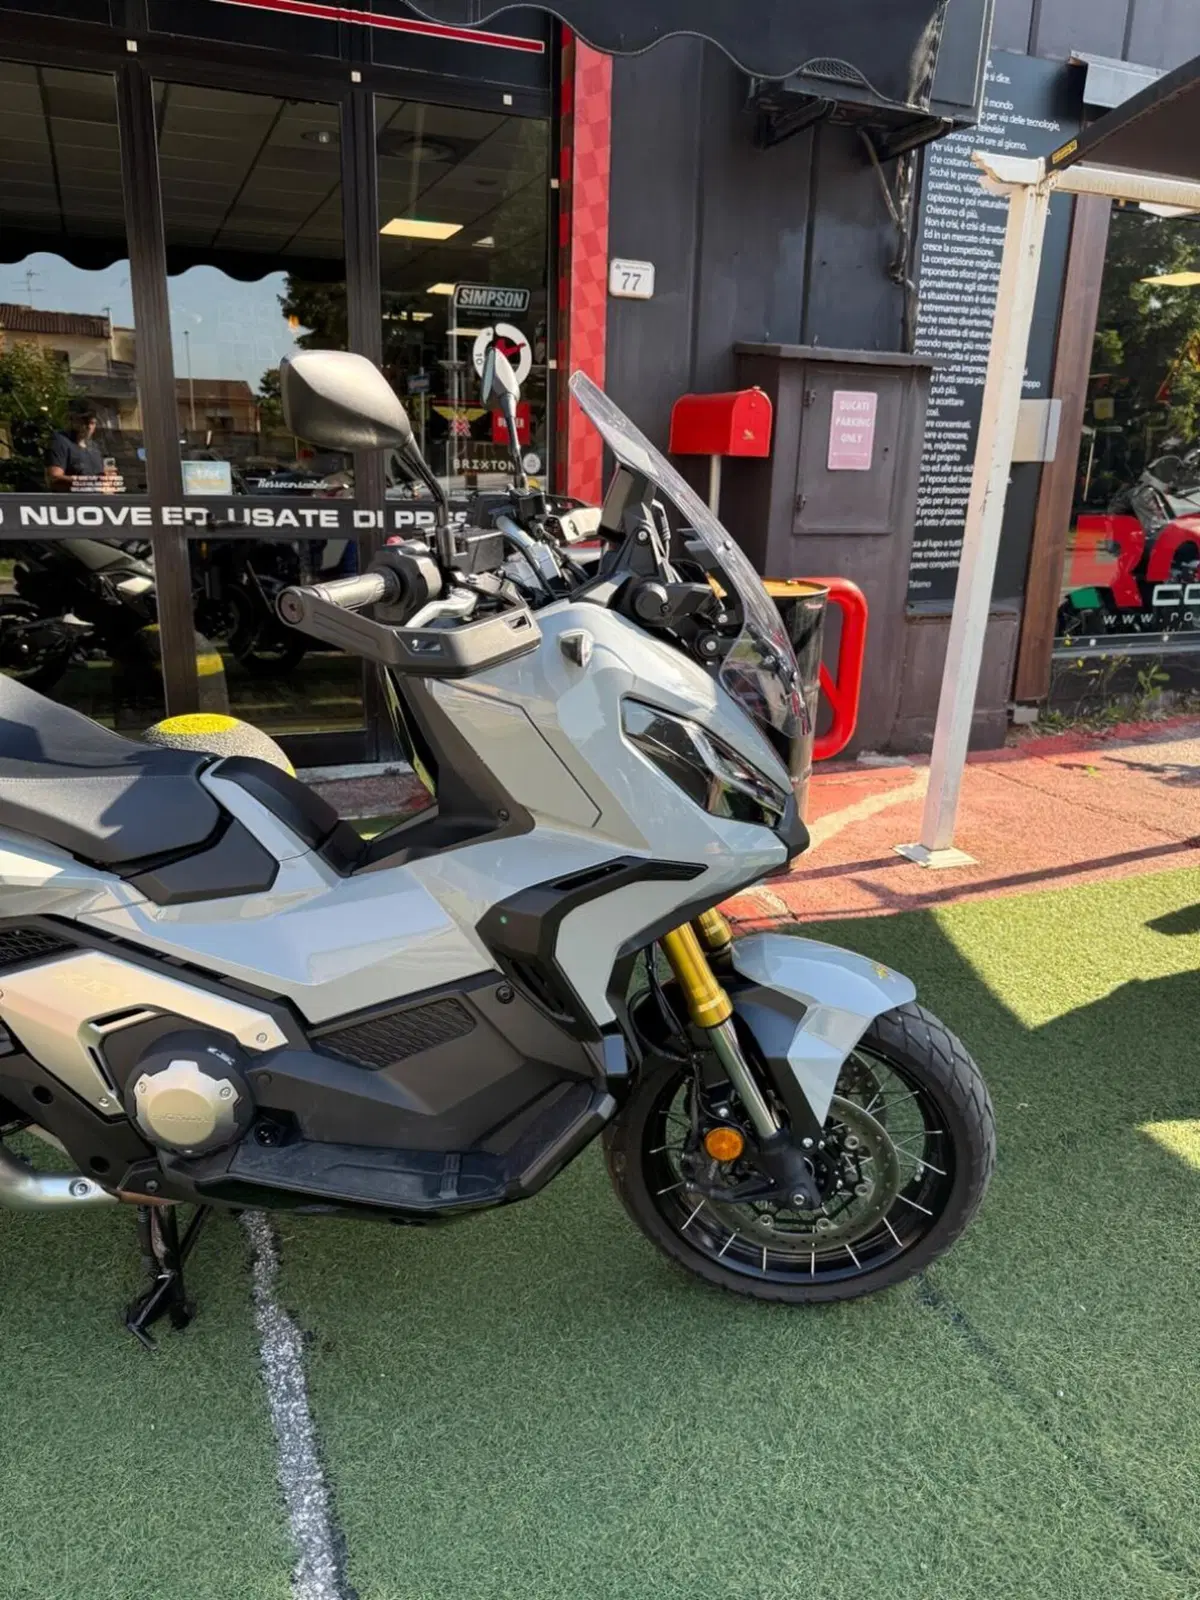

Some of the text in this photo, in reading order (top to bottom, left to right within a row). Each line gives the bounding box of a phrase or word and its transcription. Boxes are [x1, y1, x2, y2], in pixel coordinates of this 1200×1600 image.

[989, 99, 1014, 111] mondo
[1009, 114, 1026, 126] delle
[931, 141, 943, 151] Per
[943, 143, 953, 153] via
[976, 135, 985, 144] 24
[985, 137, 997, 147] ore
[930, 155, 943, 164] che
[943, 157, 969, 168] costano
[926, 204, 959, 217] Chiedono
[925, 217, 940, 227] Non
[924, 229, 933, 239] Ed
[923, 243, 943, 252] cresce
[922, 254, 930, 263] La
[931, 255, 975, 267] competizione
[622, 272, 642, 291] 77
[460, 288, 526, 308] SIMPSON
[919, 290, 927, 299] La
[927, 290, 960, 302] situazione
[923, 304, 970, 315] estremamente
[938, 316, 958, 325] molto
[453, 458, 515, 471] BRIXTON
[20, 505, 153, 526] NUOVE
[162, 506, 210, 526] ED
[227, 508, 340, 529] USATE
[353, 510, 384, 529] DI
